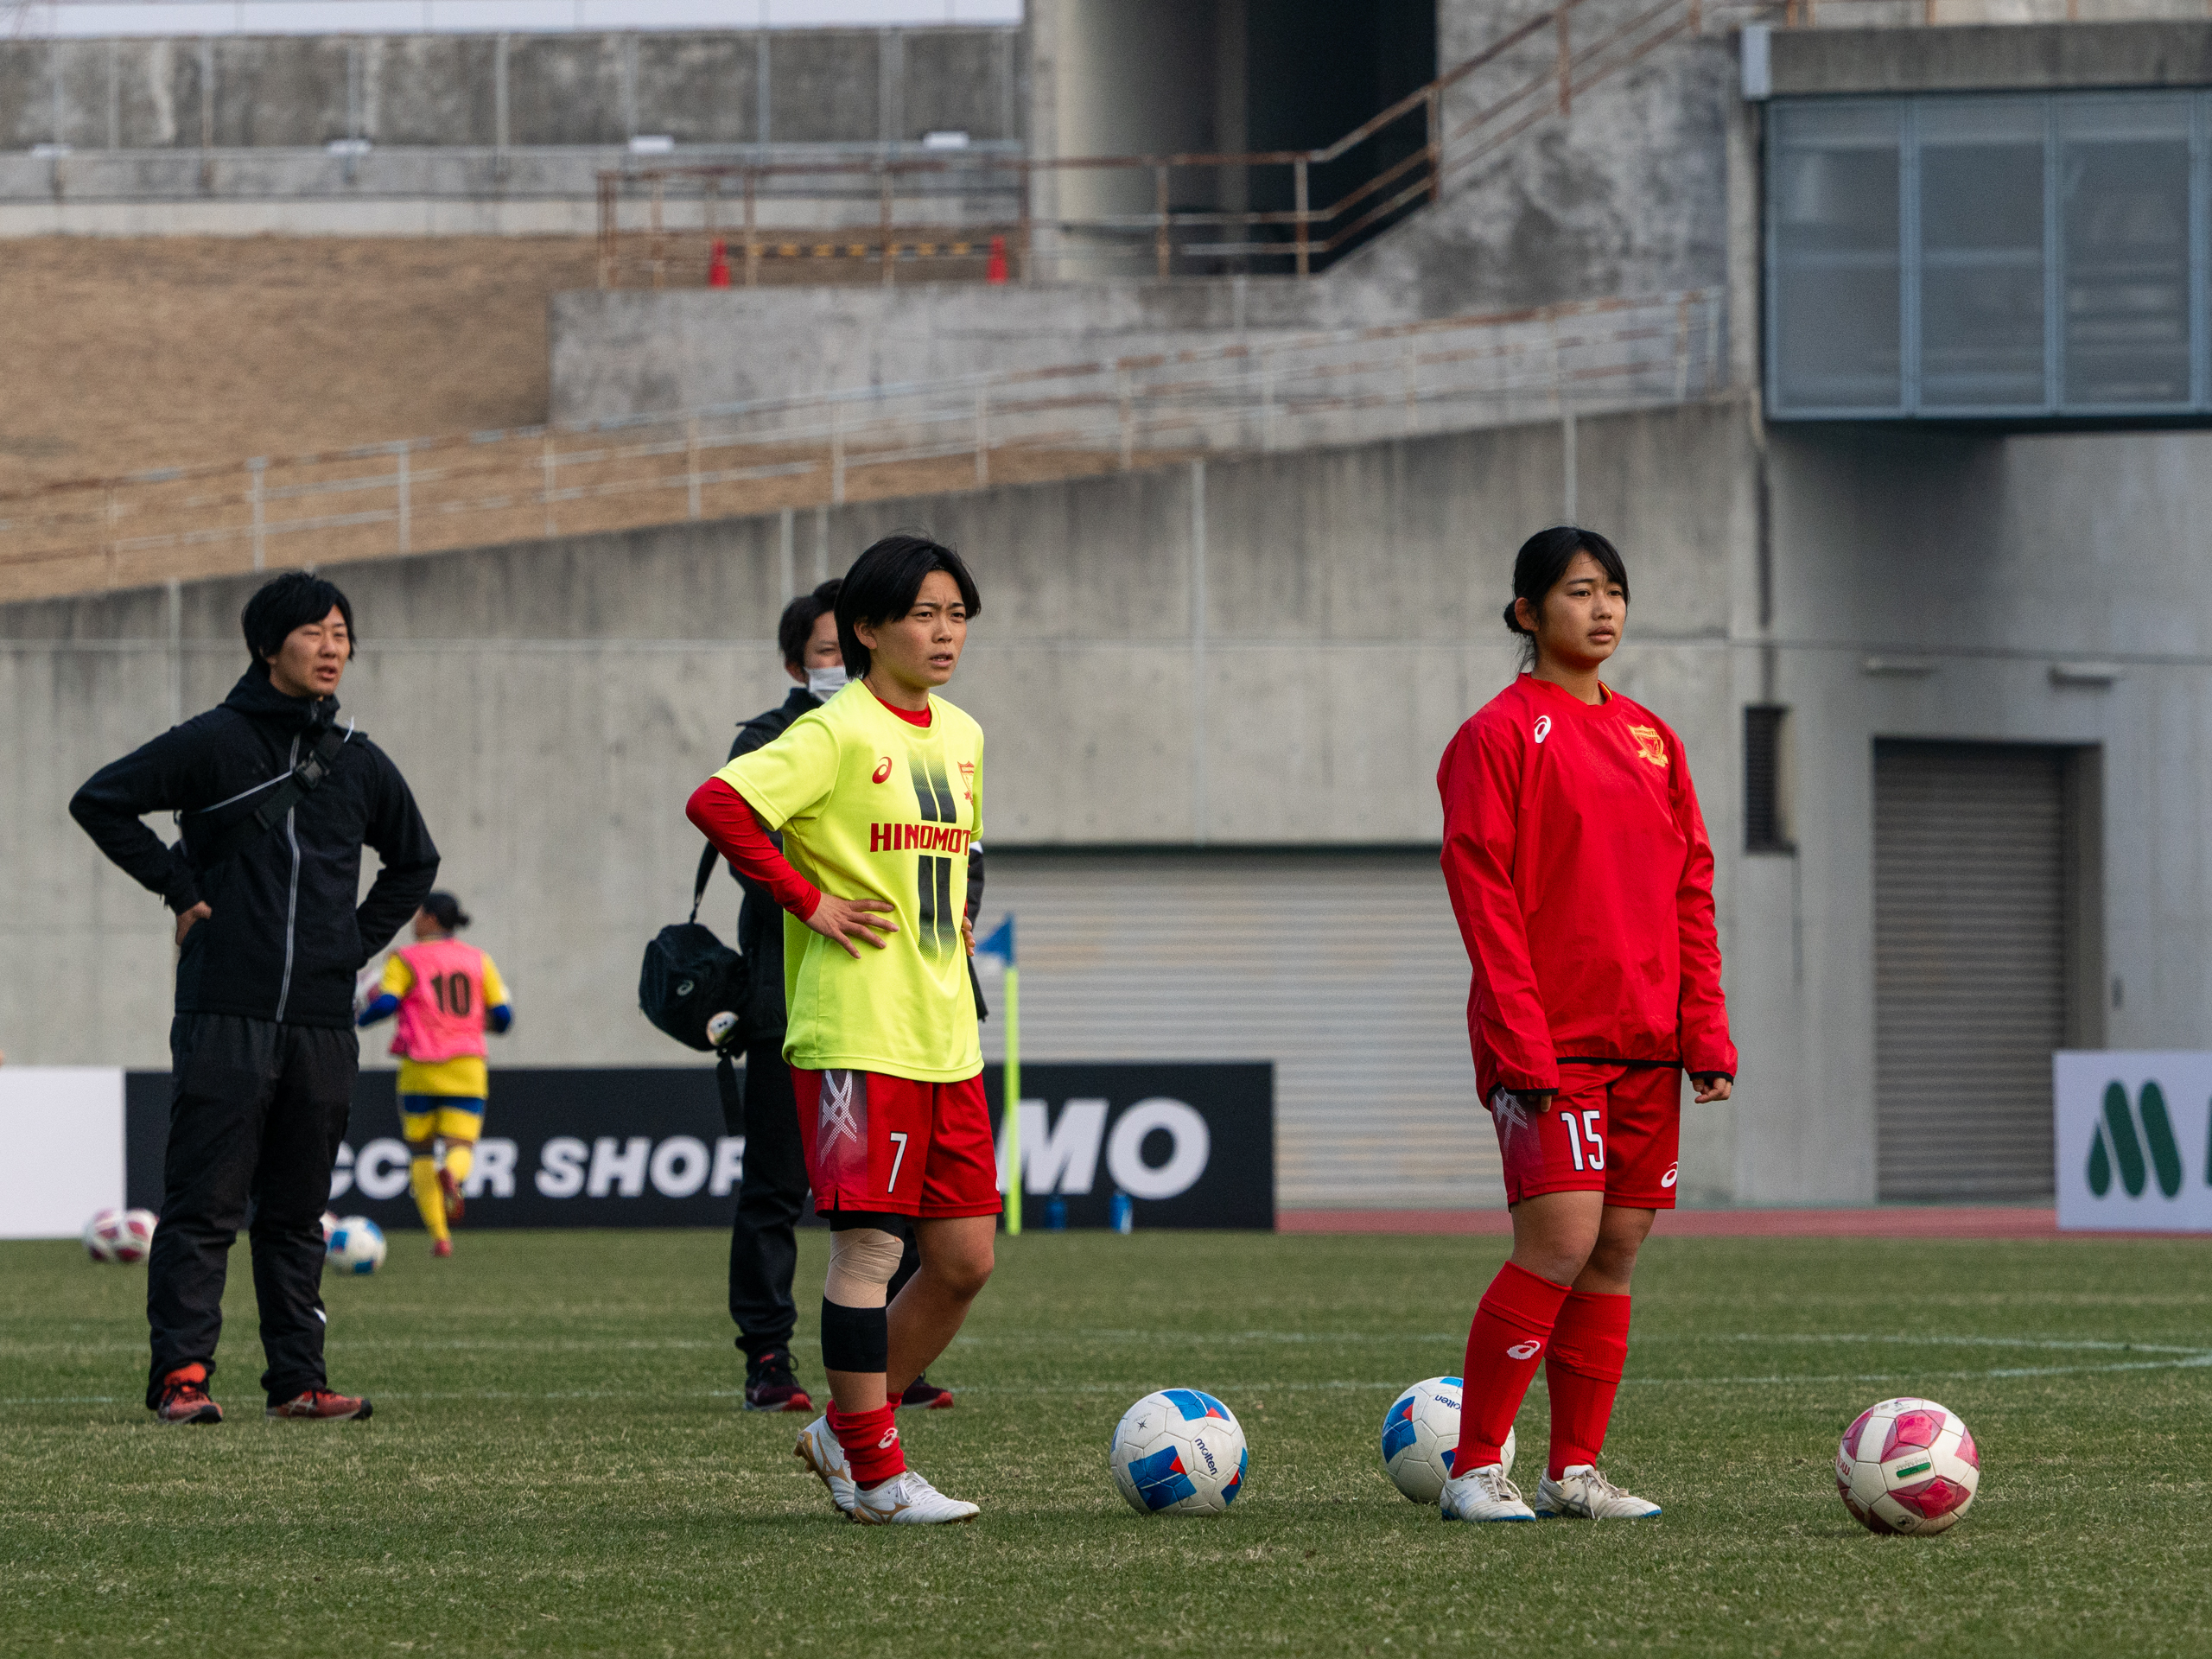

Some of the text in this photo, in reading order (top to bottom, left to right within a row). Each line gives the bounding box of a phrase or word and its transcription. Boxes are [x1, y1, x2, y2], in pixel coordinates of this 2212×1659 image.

[870, 823, 971, 856] HINOMOT
[431, 972, 469, 1016] 10
[995, 1096, 1209, 1199] MO
[1560, 1109, 1605, 1171] 15
[887, 1131, 907, 1194] 7
[1434, 1394, 1462, 1411] olten
[1194, 1438, 1217, 1476] molten
